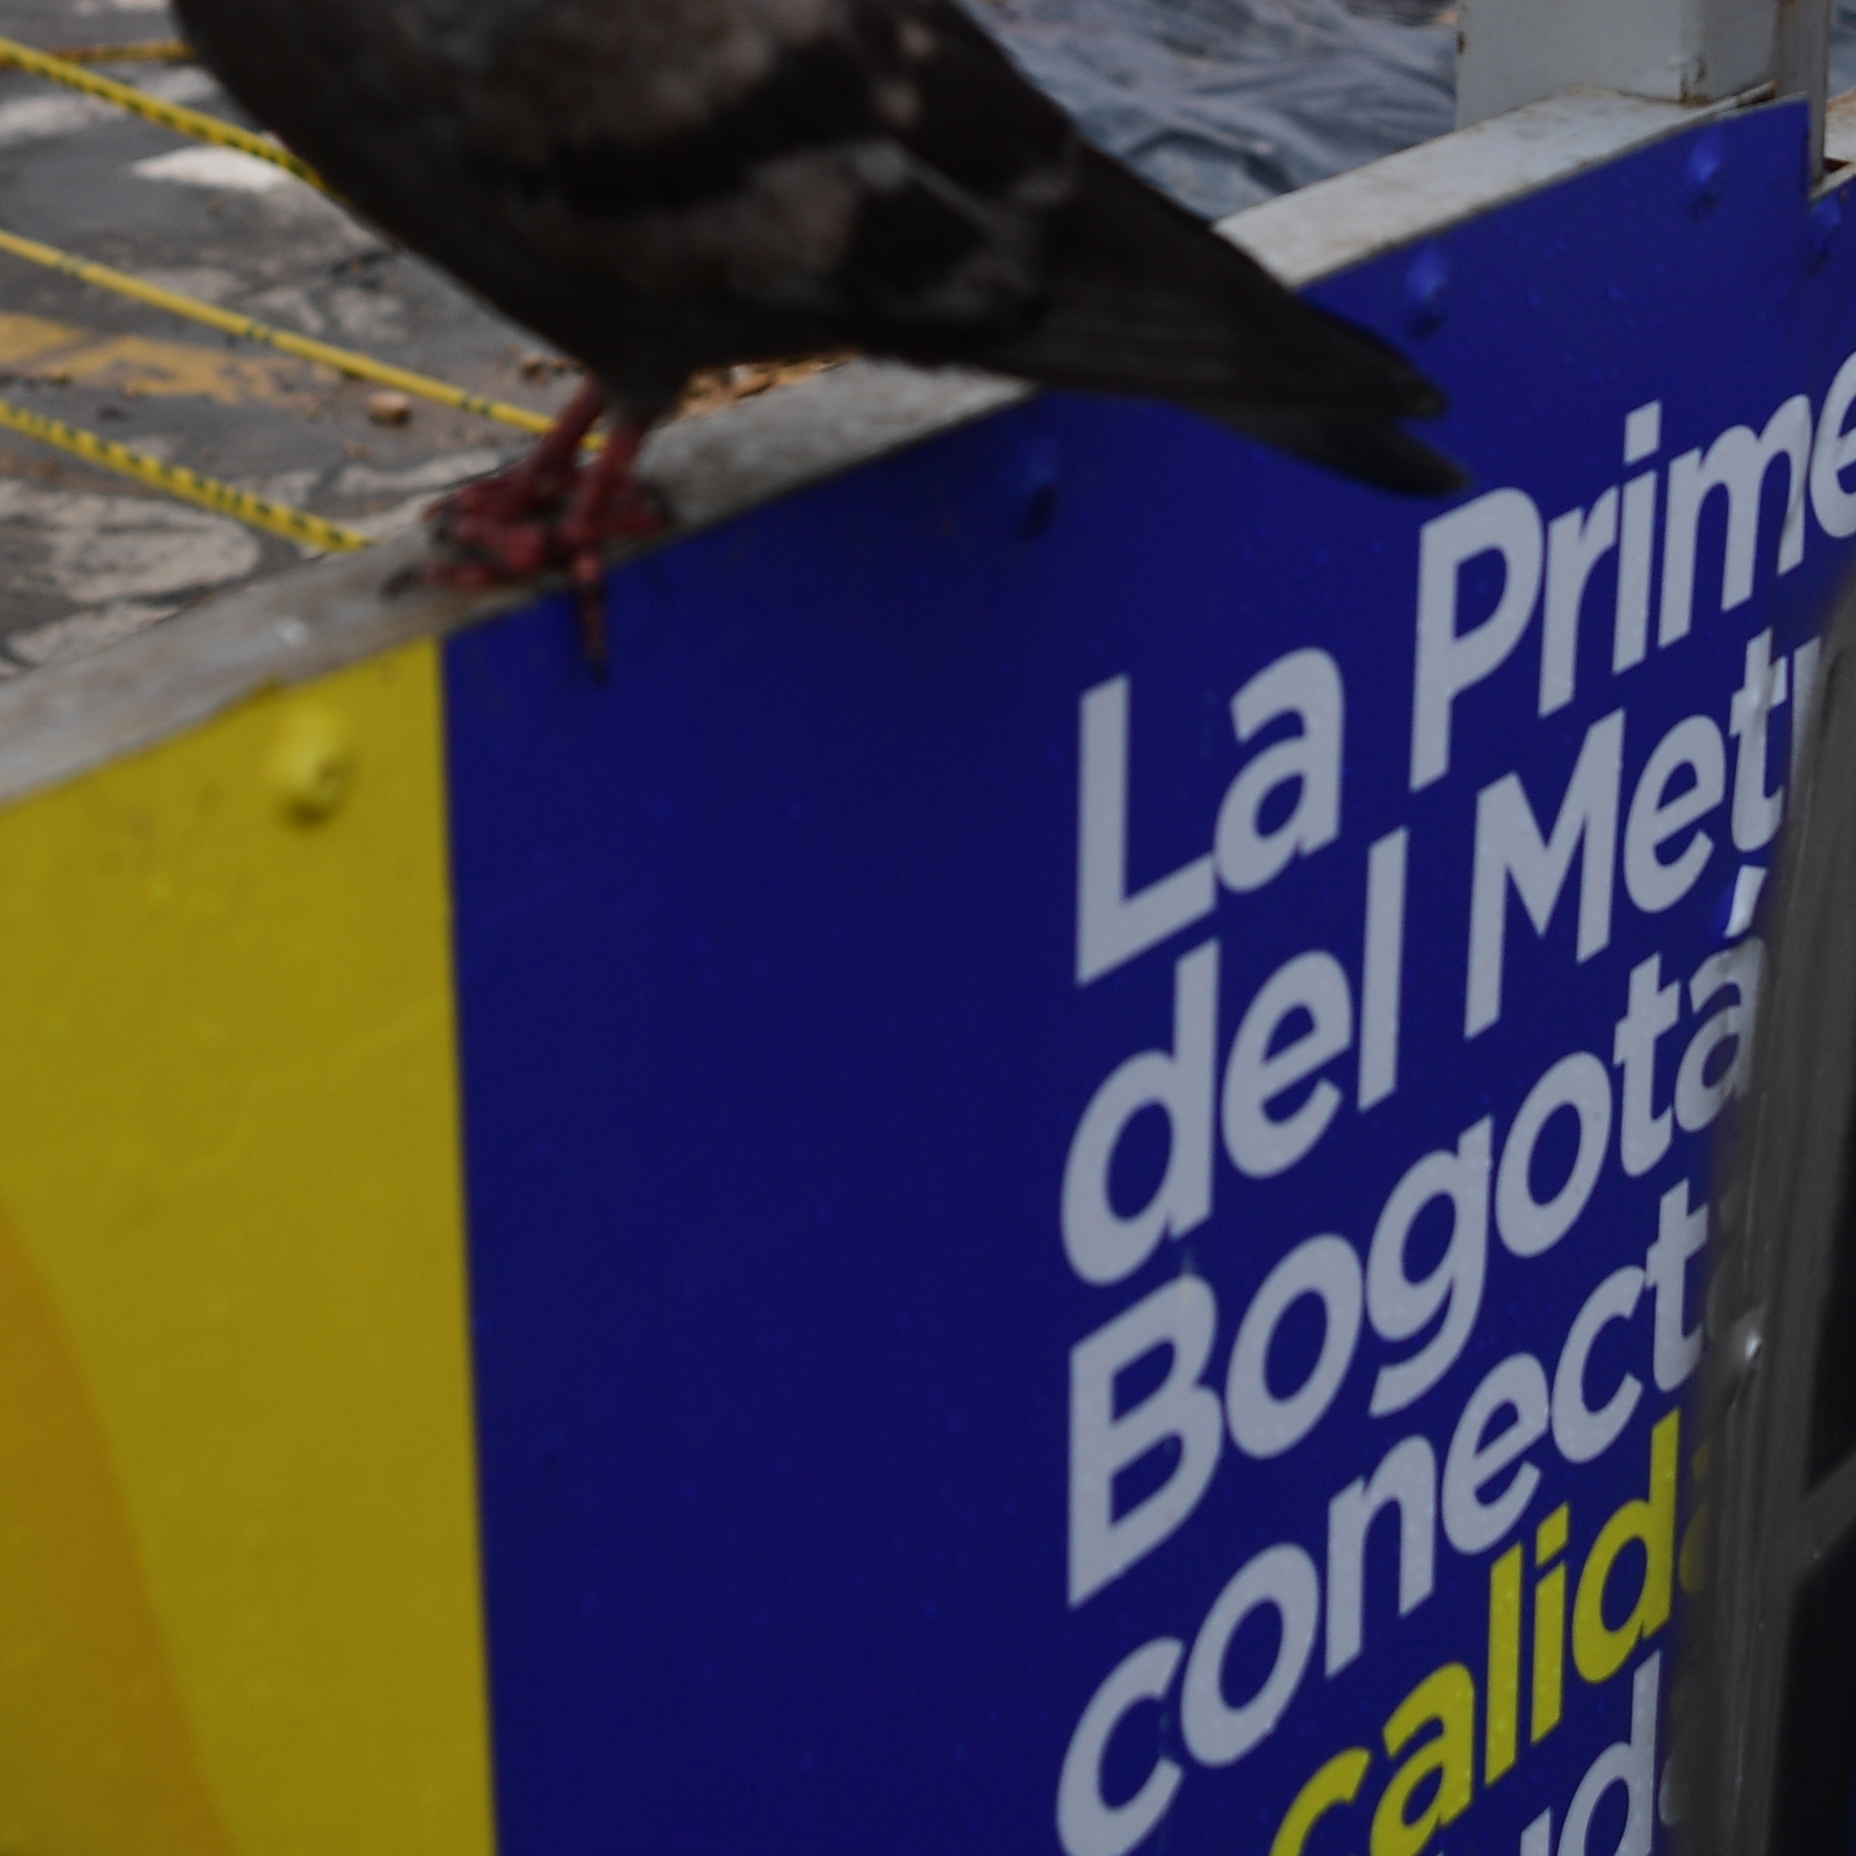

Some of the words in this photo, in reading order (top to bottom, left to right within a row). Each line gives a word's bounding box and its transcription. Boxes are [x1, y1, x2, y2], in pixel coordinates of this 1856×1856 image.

[1075, 648, 1344, 987] La
[1061, 828, 1408, 1284] del
[1068, 864, 1766, 1603] Bogotá
[1056, 1178, 1714, 1856] conect
[1268, 1410, 1682, 1856] calid
